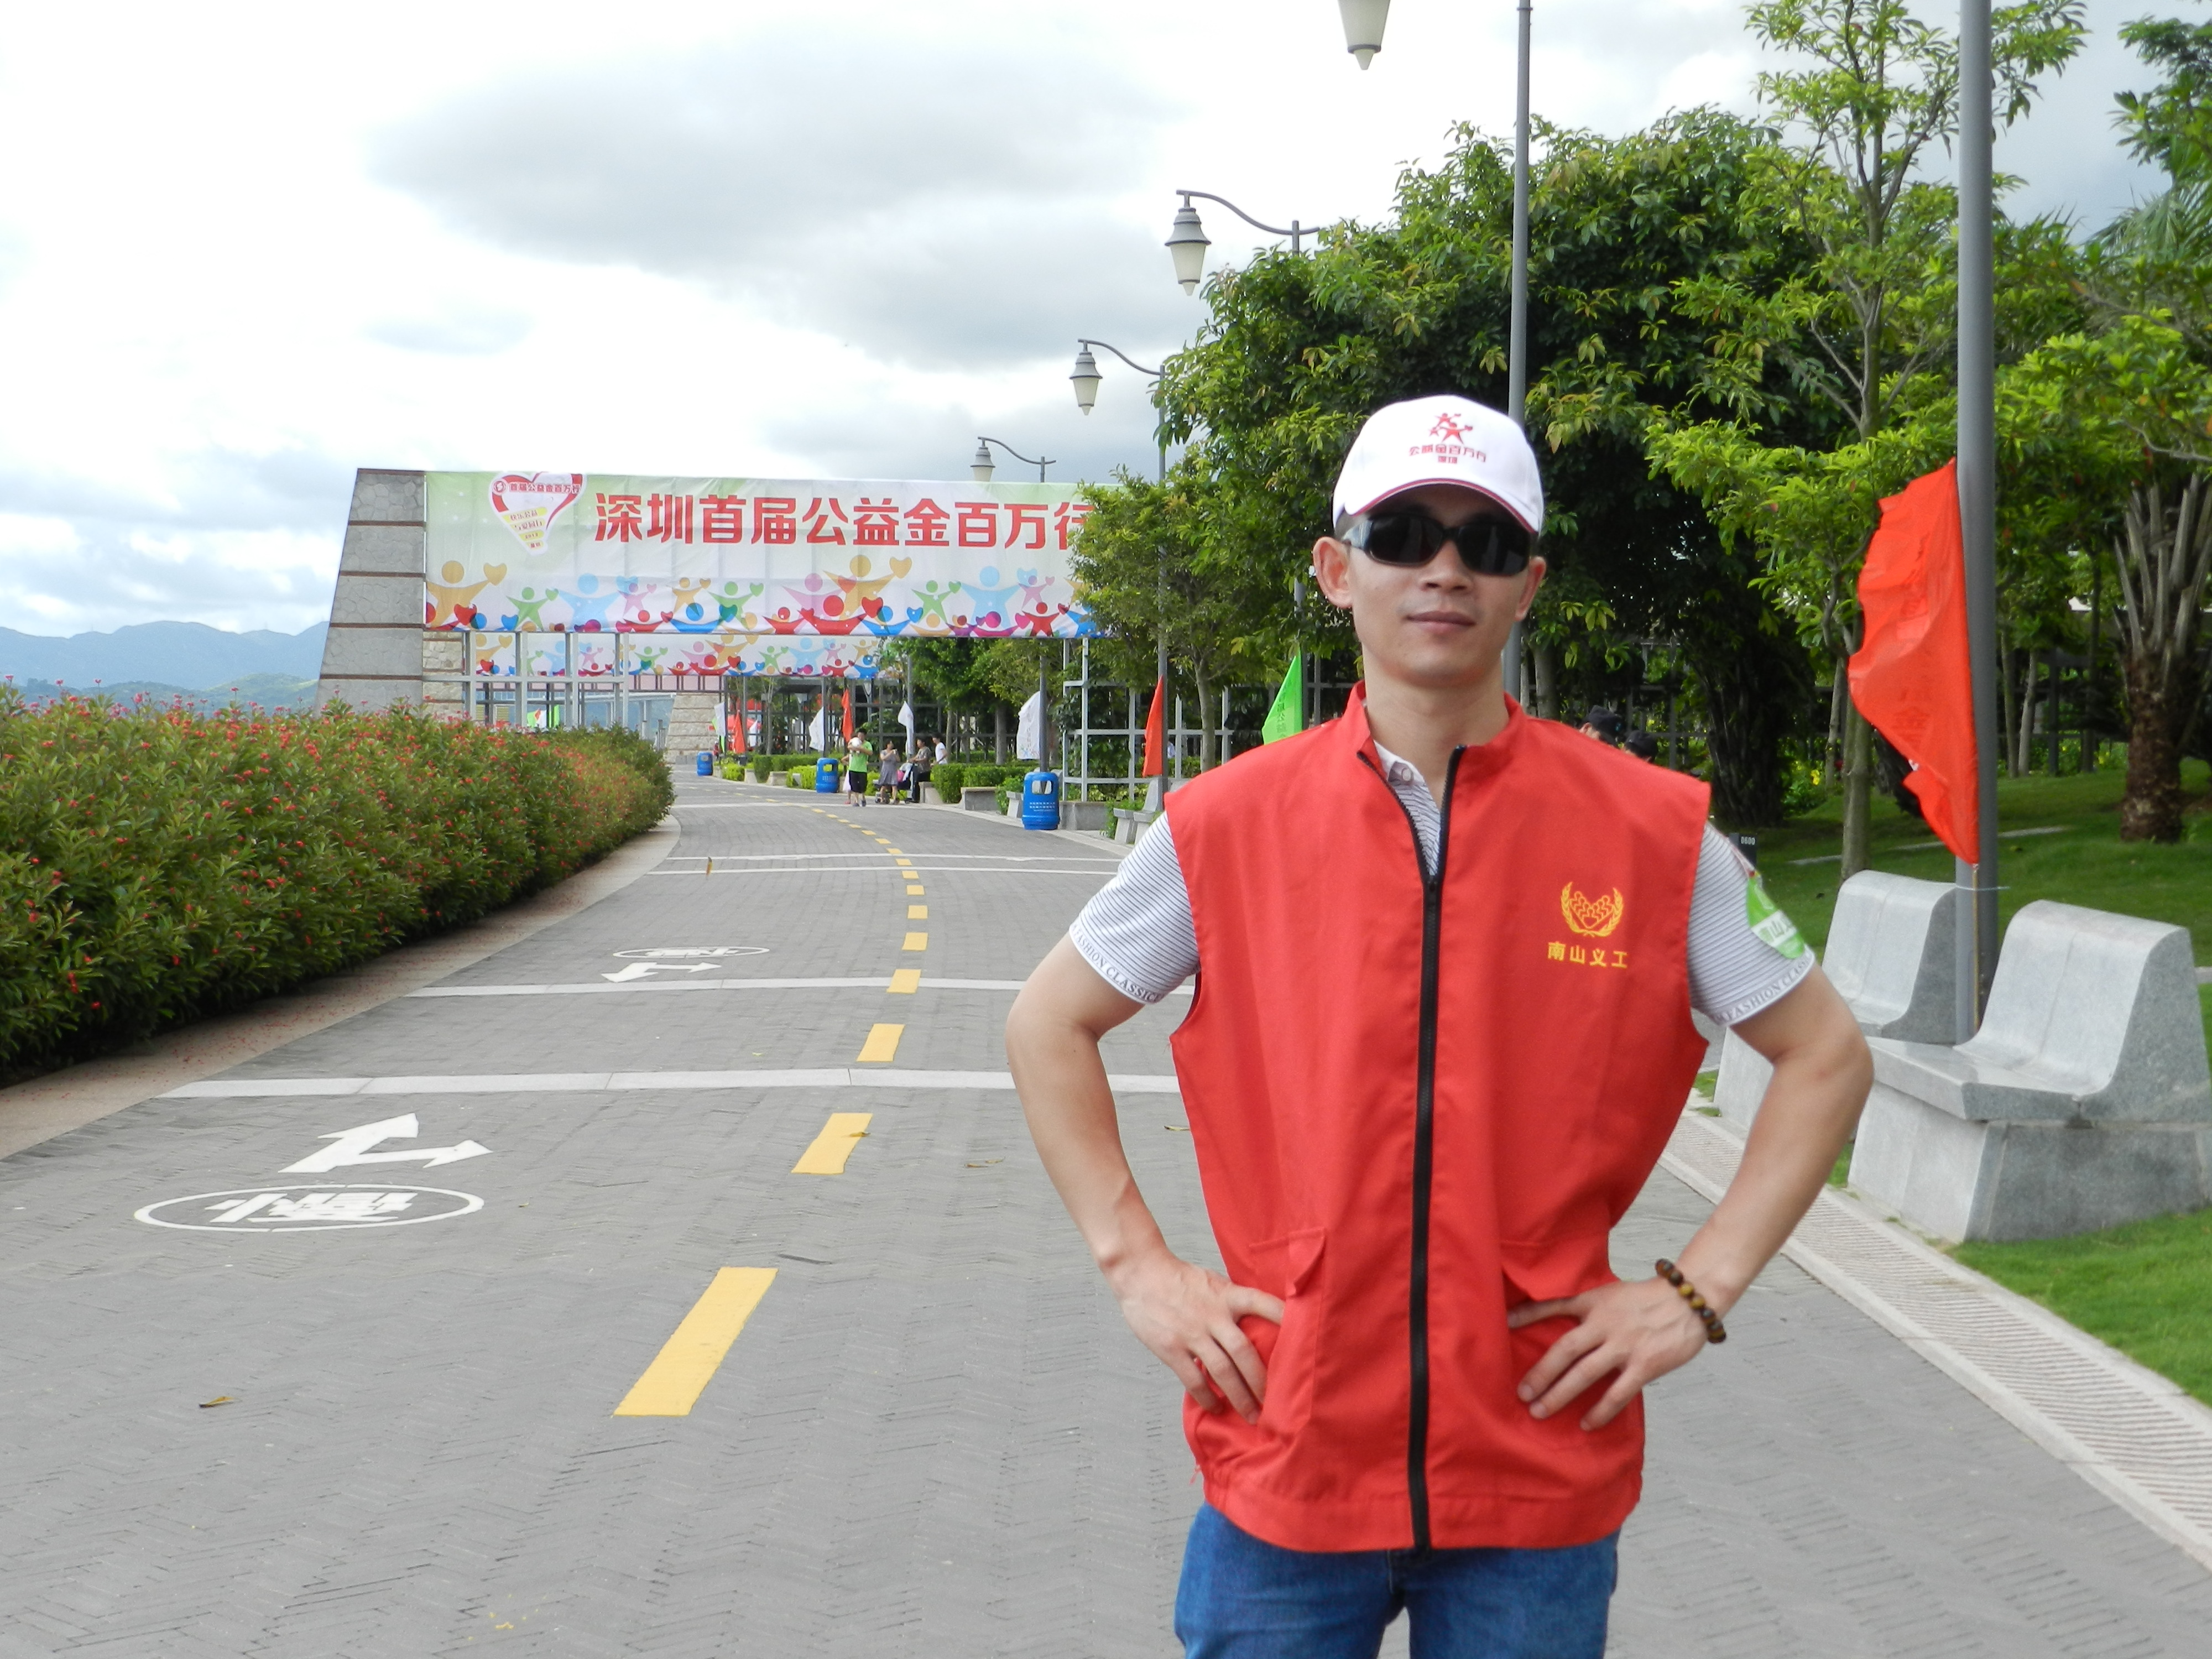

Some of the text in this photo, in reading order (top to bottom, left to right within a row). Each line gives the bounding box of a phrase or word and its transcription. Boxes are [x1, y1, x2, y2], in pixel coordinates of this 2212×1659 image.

[595, 493, 1094, 550] 深圳首届公益金百万行
[1548, 941, 1627, 968] 南山义工
